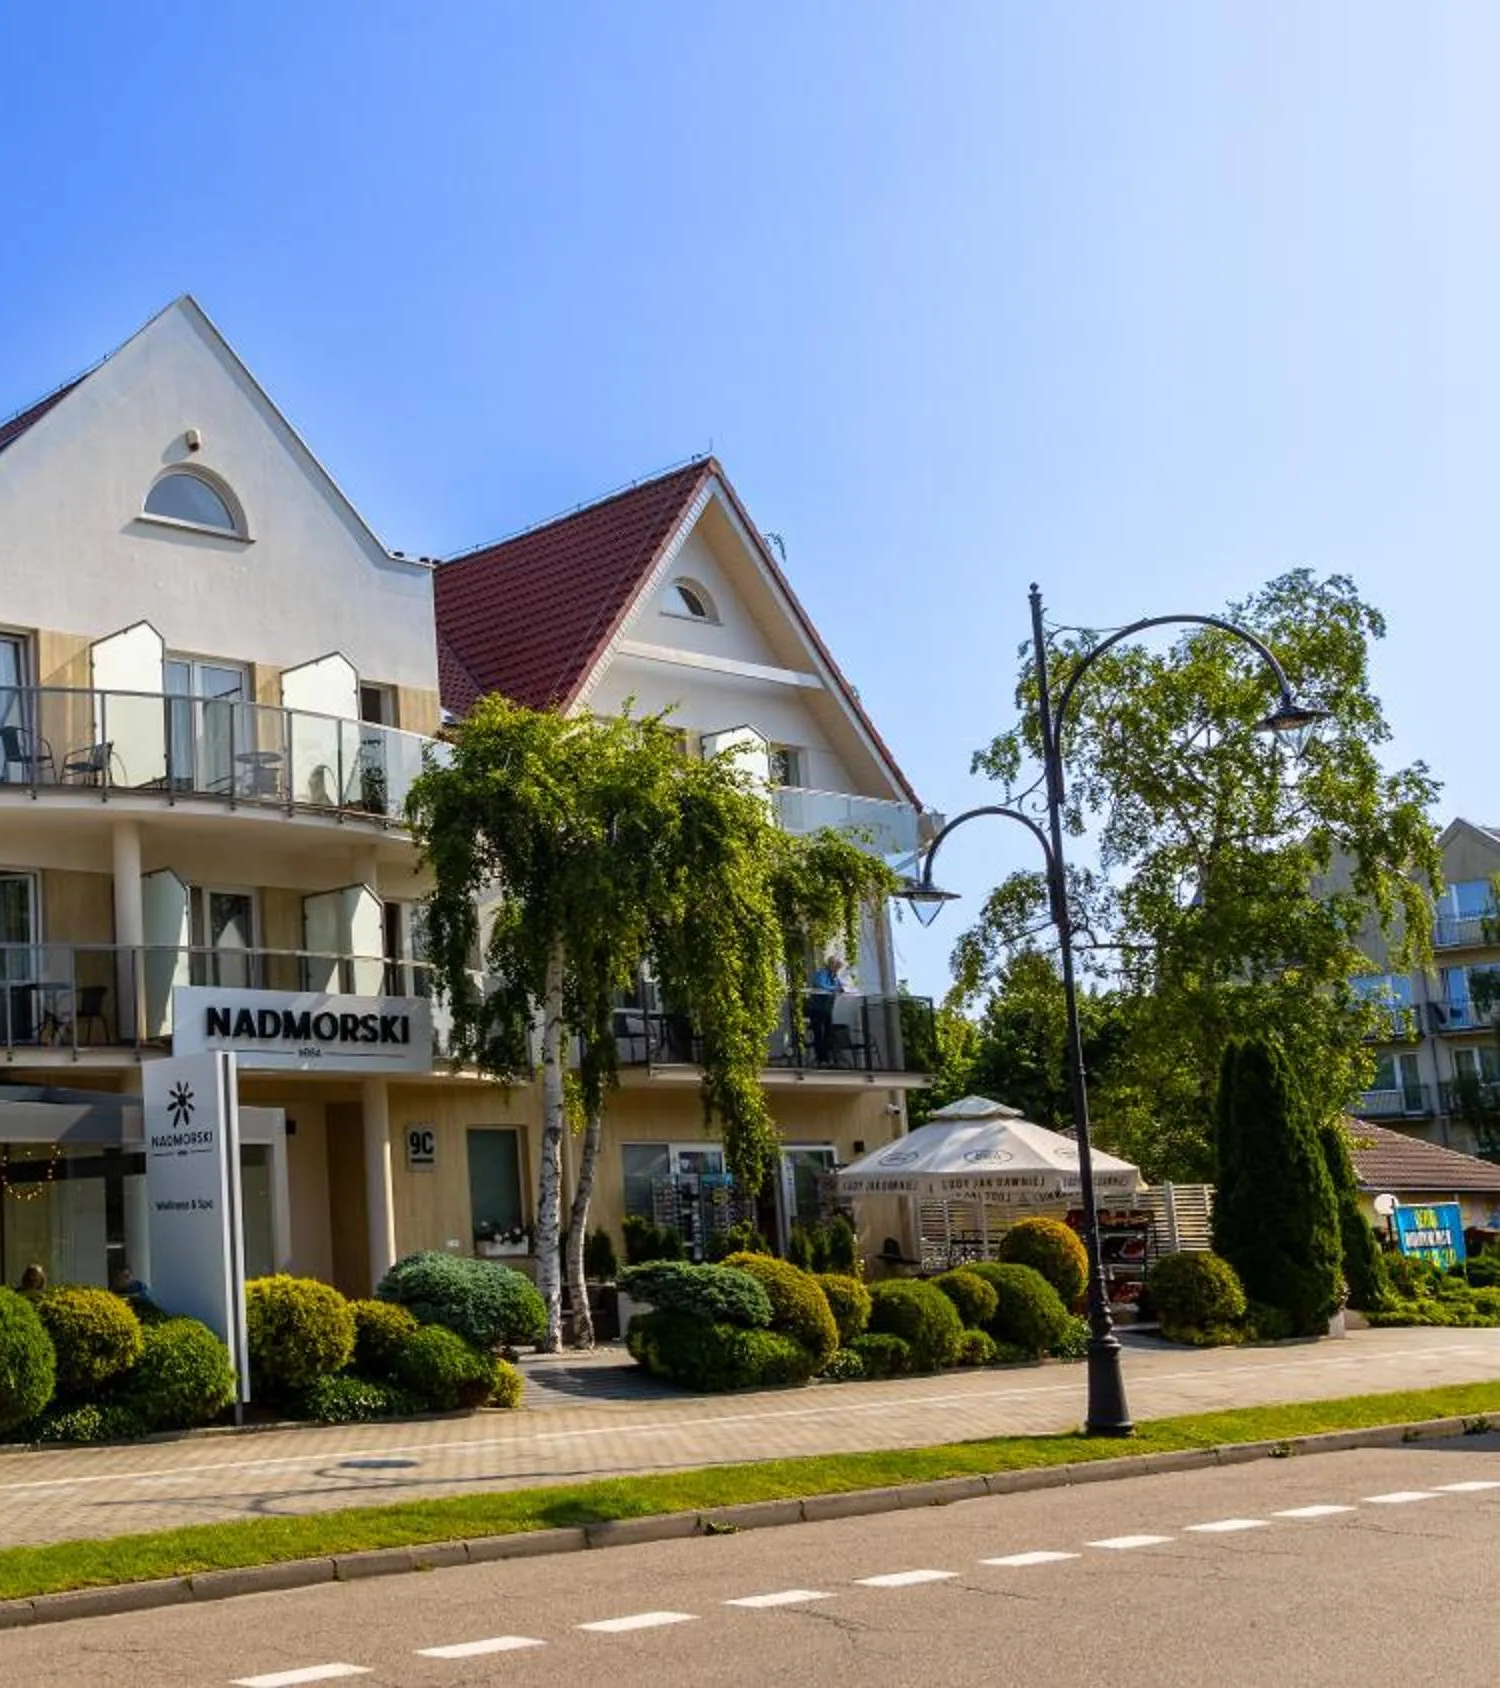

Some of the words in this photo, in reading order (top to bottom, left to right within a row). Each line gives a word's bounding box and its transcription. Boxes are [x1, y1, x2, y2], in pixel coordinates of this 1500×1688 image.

[206, 1007, 410, 1044] NADMORSKI
[151, 1131, 213, 1148] NADMORSKI
[409, 1131, 435, 1154] 9C
[973, 1178, 993, 1189] JAK
[997, 1176, 1046, 1188] DAWNIEJ
